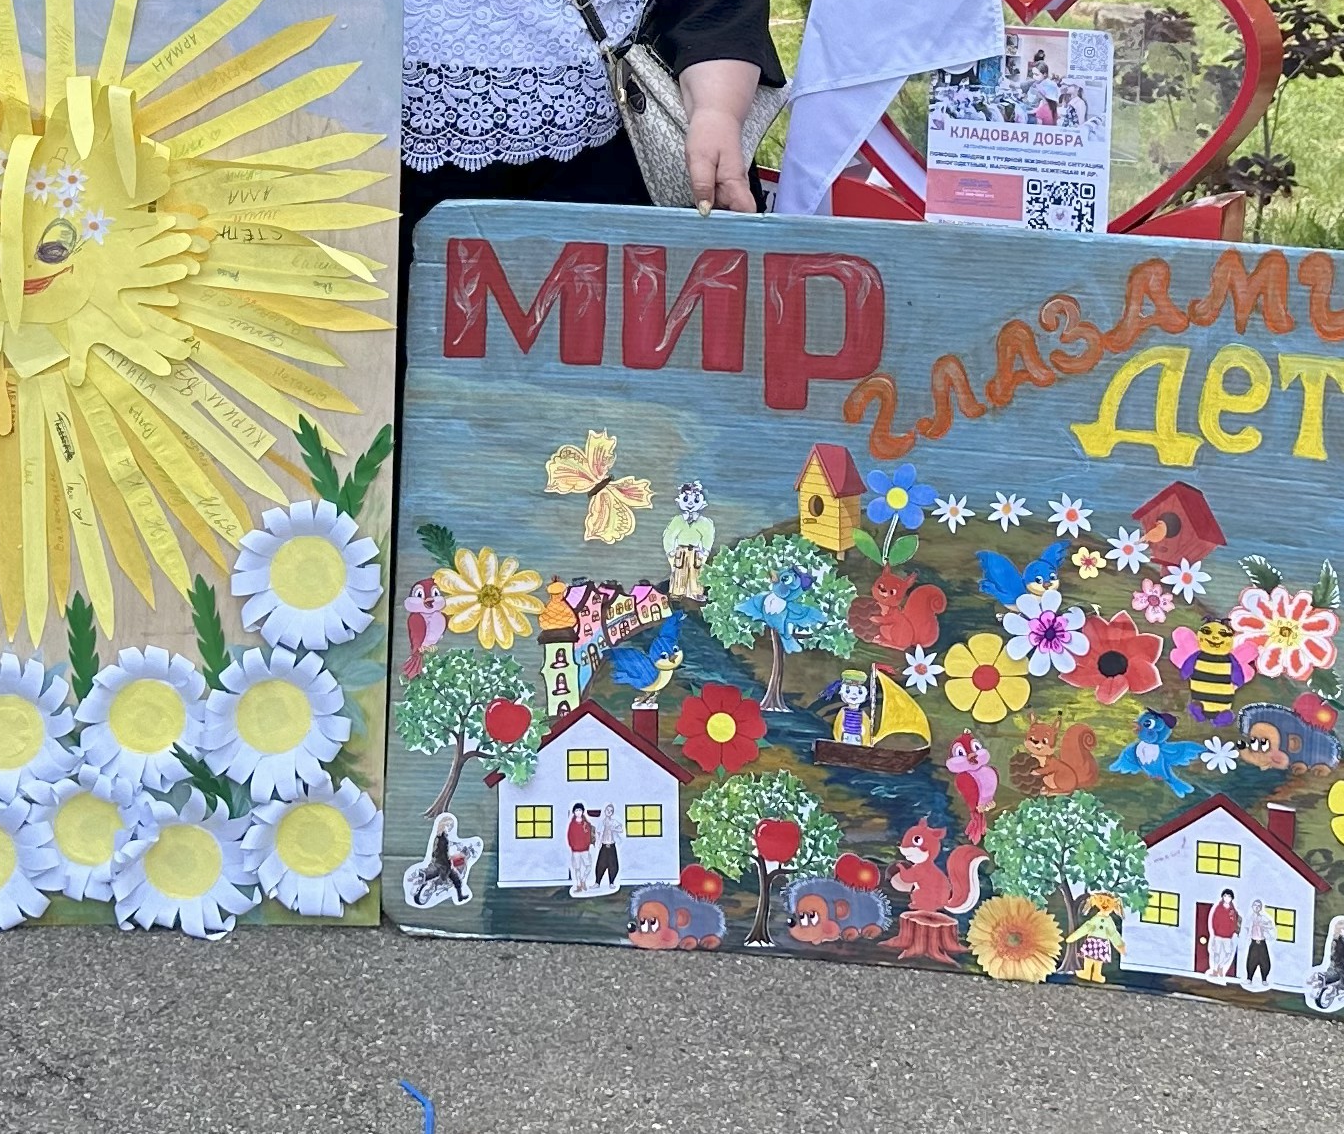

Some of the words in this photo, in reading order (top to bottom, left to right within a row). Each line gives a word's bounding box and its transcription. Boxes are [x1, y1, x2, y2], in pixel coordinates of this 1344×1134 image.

[151, 31, 197, 74] АРМАН
[950, 126, 1029, 144] КЛАДОВАЯ
[1033, 132, 1084, 147] ДОБРА
[443, 237, 886, 411] МИР
[104, 348, 157, 397] АРИНА
[193, 492, 239, 539] Илья
